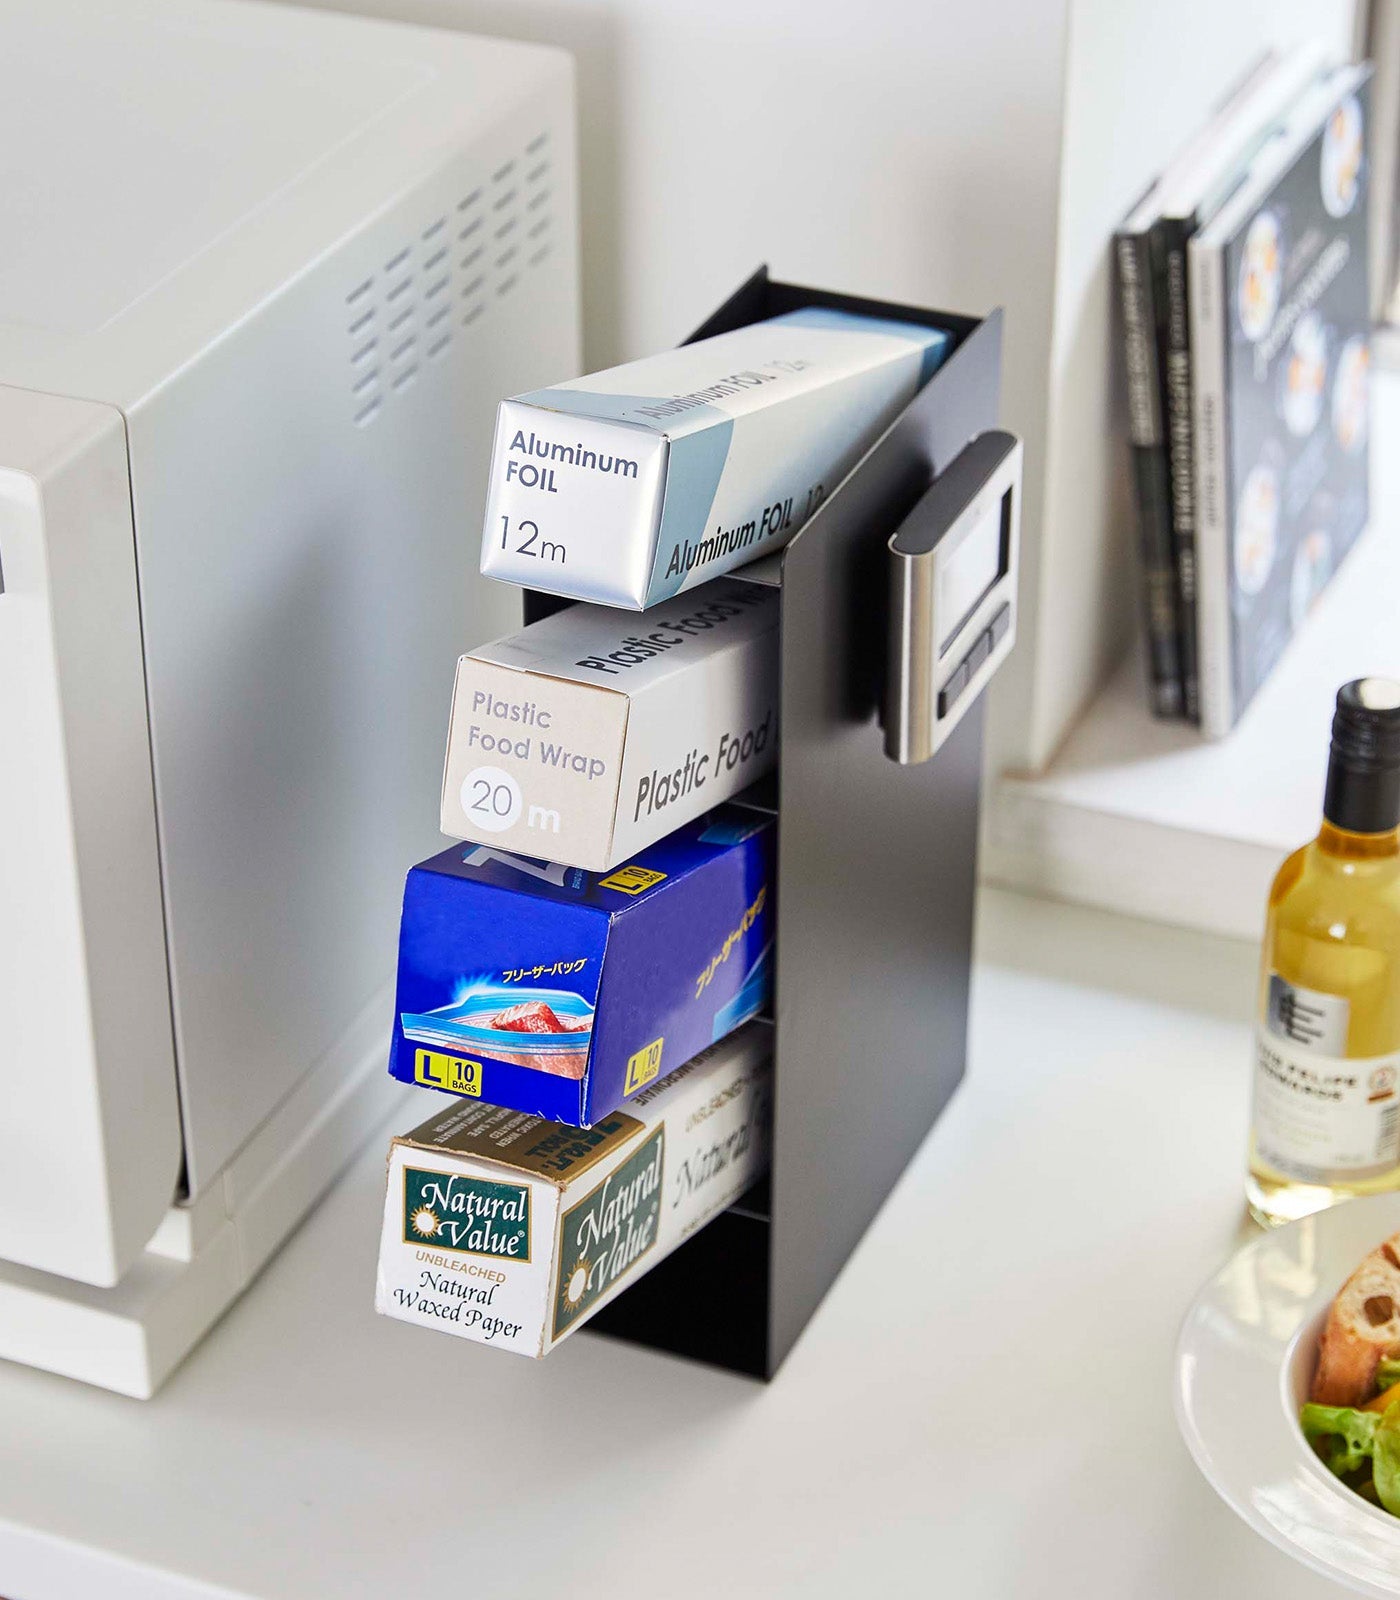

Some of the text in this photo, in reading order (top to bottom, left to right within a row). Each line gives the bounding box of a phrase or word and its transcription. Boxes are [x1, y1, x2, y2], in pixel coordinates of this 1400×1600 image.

[634, 383, 740, 420] Aluminum
[719, 370, 777, 390] FOIL
[505, 460, 558, 494] FOIL
[509, 430, 639, 479] Aluminum
[500, 515, 567, 564] 12m
[664, 519, 757, 580] Aluminum
[755, 496, 794, 542] FOIL
[575, 602, 742, 675] Plastic Food
[472, 690, 552, 730] Plastic
[467, 726, 607, 781] Food Wrap
[633, 709, 772, 823] Plastic Food
[469, 778, 561, 835] 20 m
[606, 868, 646, 891] L 10
[501, 956, 589, 985] フリーザーバッグ
[422, 1054, 476, 1084] L 10
[451, 1080, 478, 1094] BAGS
[629, 1044, 659, 1090] L 10
[421, 1175, 527, 1222] Natural
[576, 1134, 662, 1260] Natural
[415, 1250, 506, 1283] UNBLEACHED
[419, 1271, 500, 1306] Natural
[393, 1288, 522, 1340] Waxed Paper
